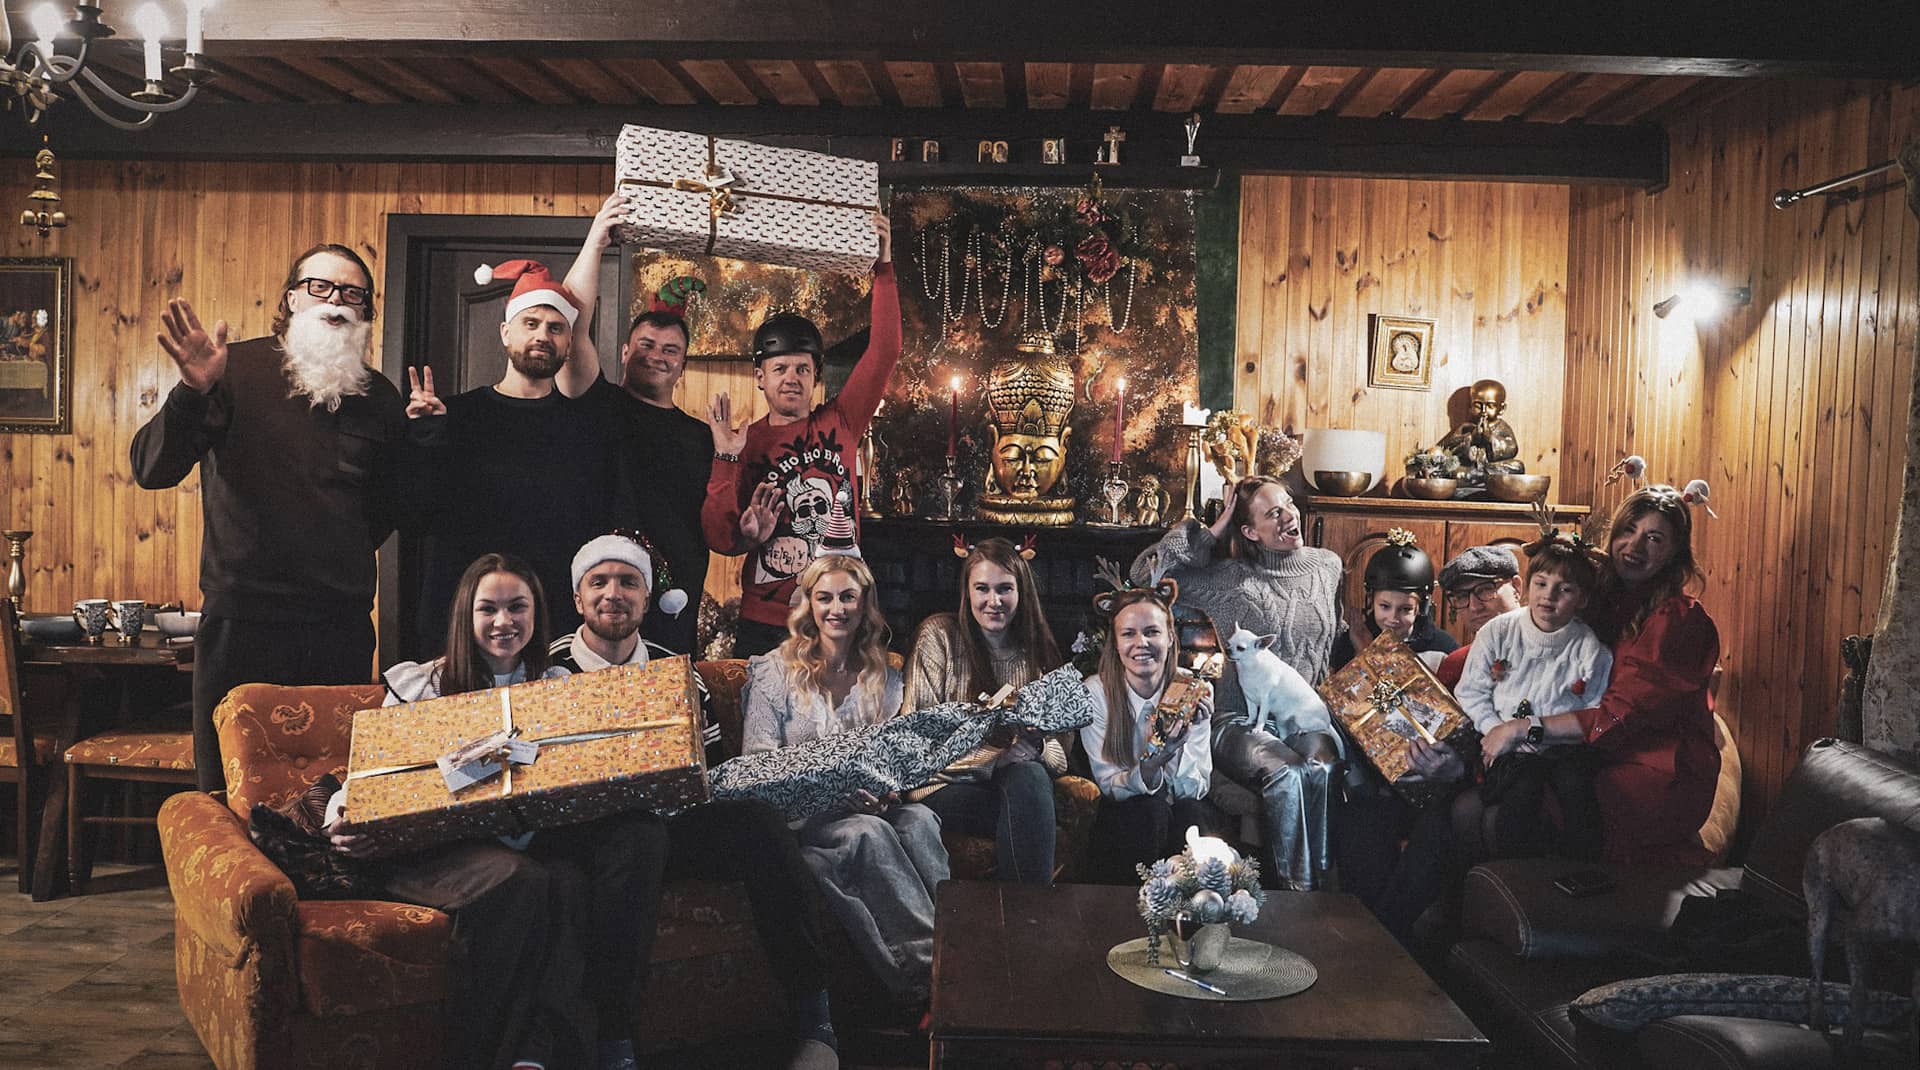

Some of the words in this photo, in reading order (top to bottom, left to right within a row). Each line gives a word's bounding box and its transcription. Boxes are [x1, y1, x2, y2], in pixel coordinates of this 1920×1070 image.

[779, 456, 799, 473] HO
[803, 448, 821, 464] HO
[824, 449, 844, 475] BRO
